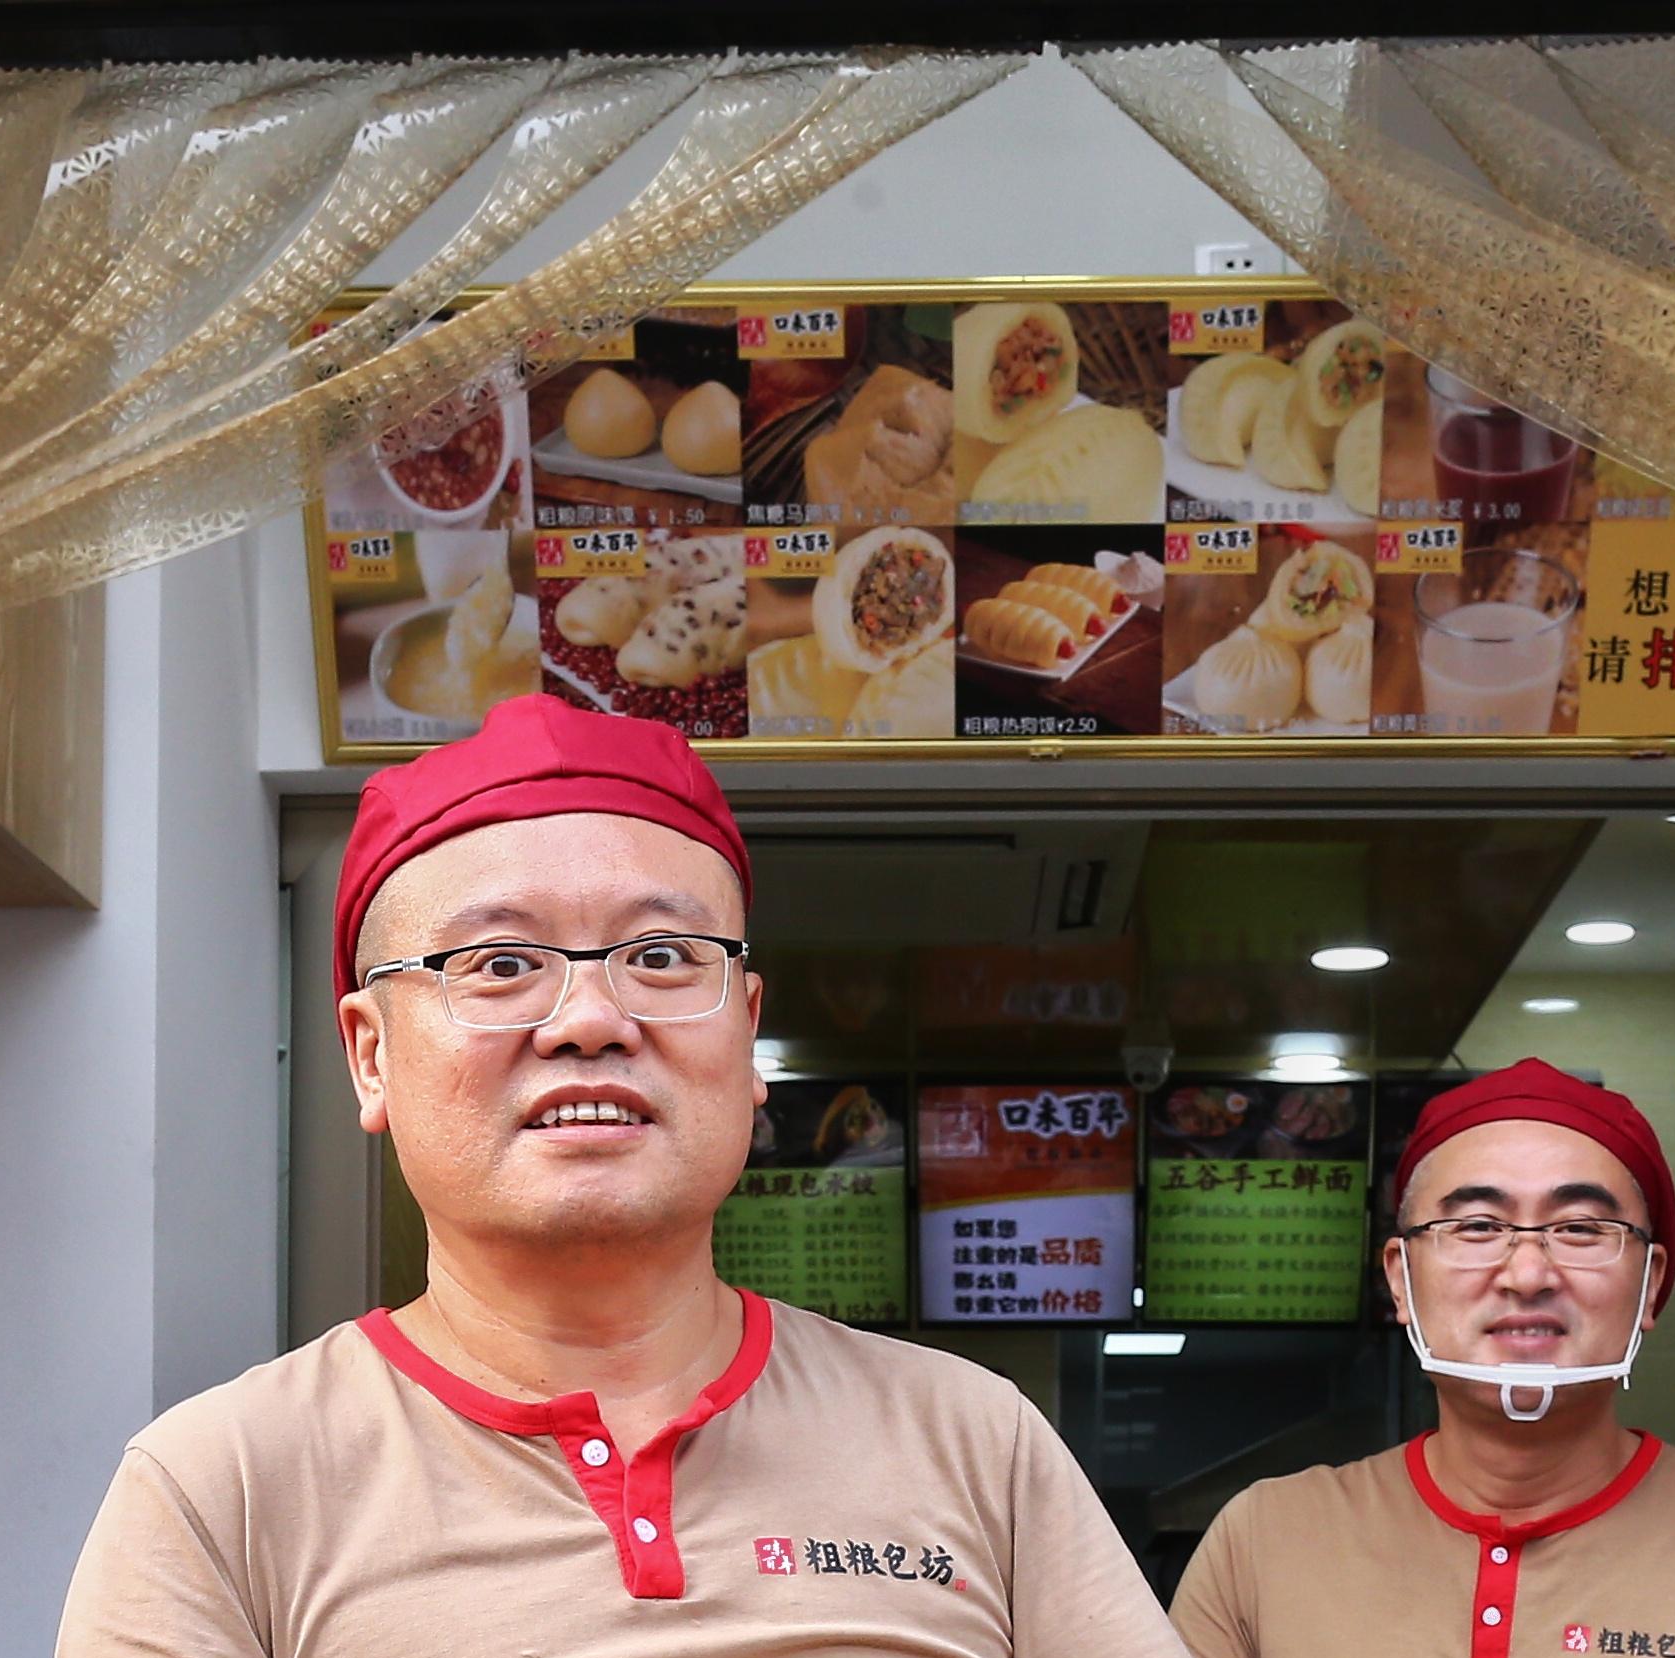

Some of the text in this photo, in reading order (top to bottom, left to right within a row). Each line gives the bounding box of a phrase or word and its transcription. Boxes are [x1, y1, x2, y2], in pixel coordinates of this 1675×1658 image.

[1159, 1162, 1354, 1195] 五谷手工鲜面
[804, 1537, 956, 1586] 粗粮包坊
